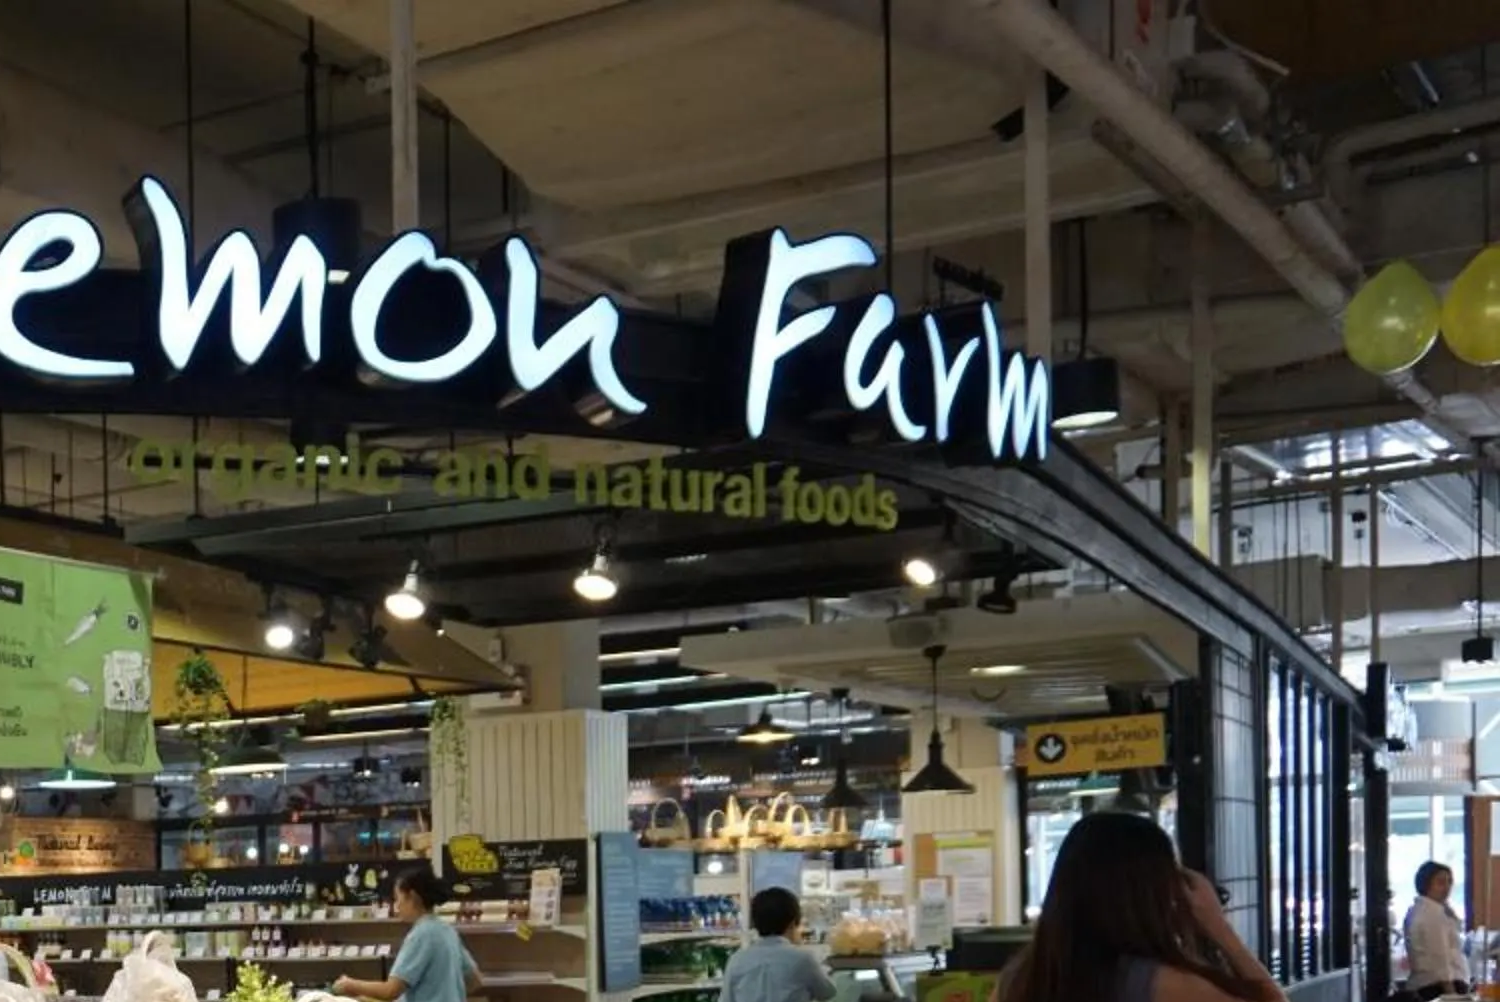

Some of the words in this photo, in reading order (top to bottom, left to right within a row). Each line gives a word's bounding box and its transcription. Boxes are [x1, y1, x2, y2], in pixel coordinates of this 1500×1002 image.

[746, 226, 1050, 460] Farm
[131, 432, 404, 498] organic
[432, 441, 551, 501] and
[575, 456, 767, 519] natural
[779, 466, 899, 531] foods
